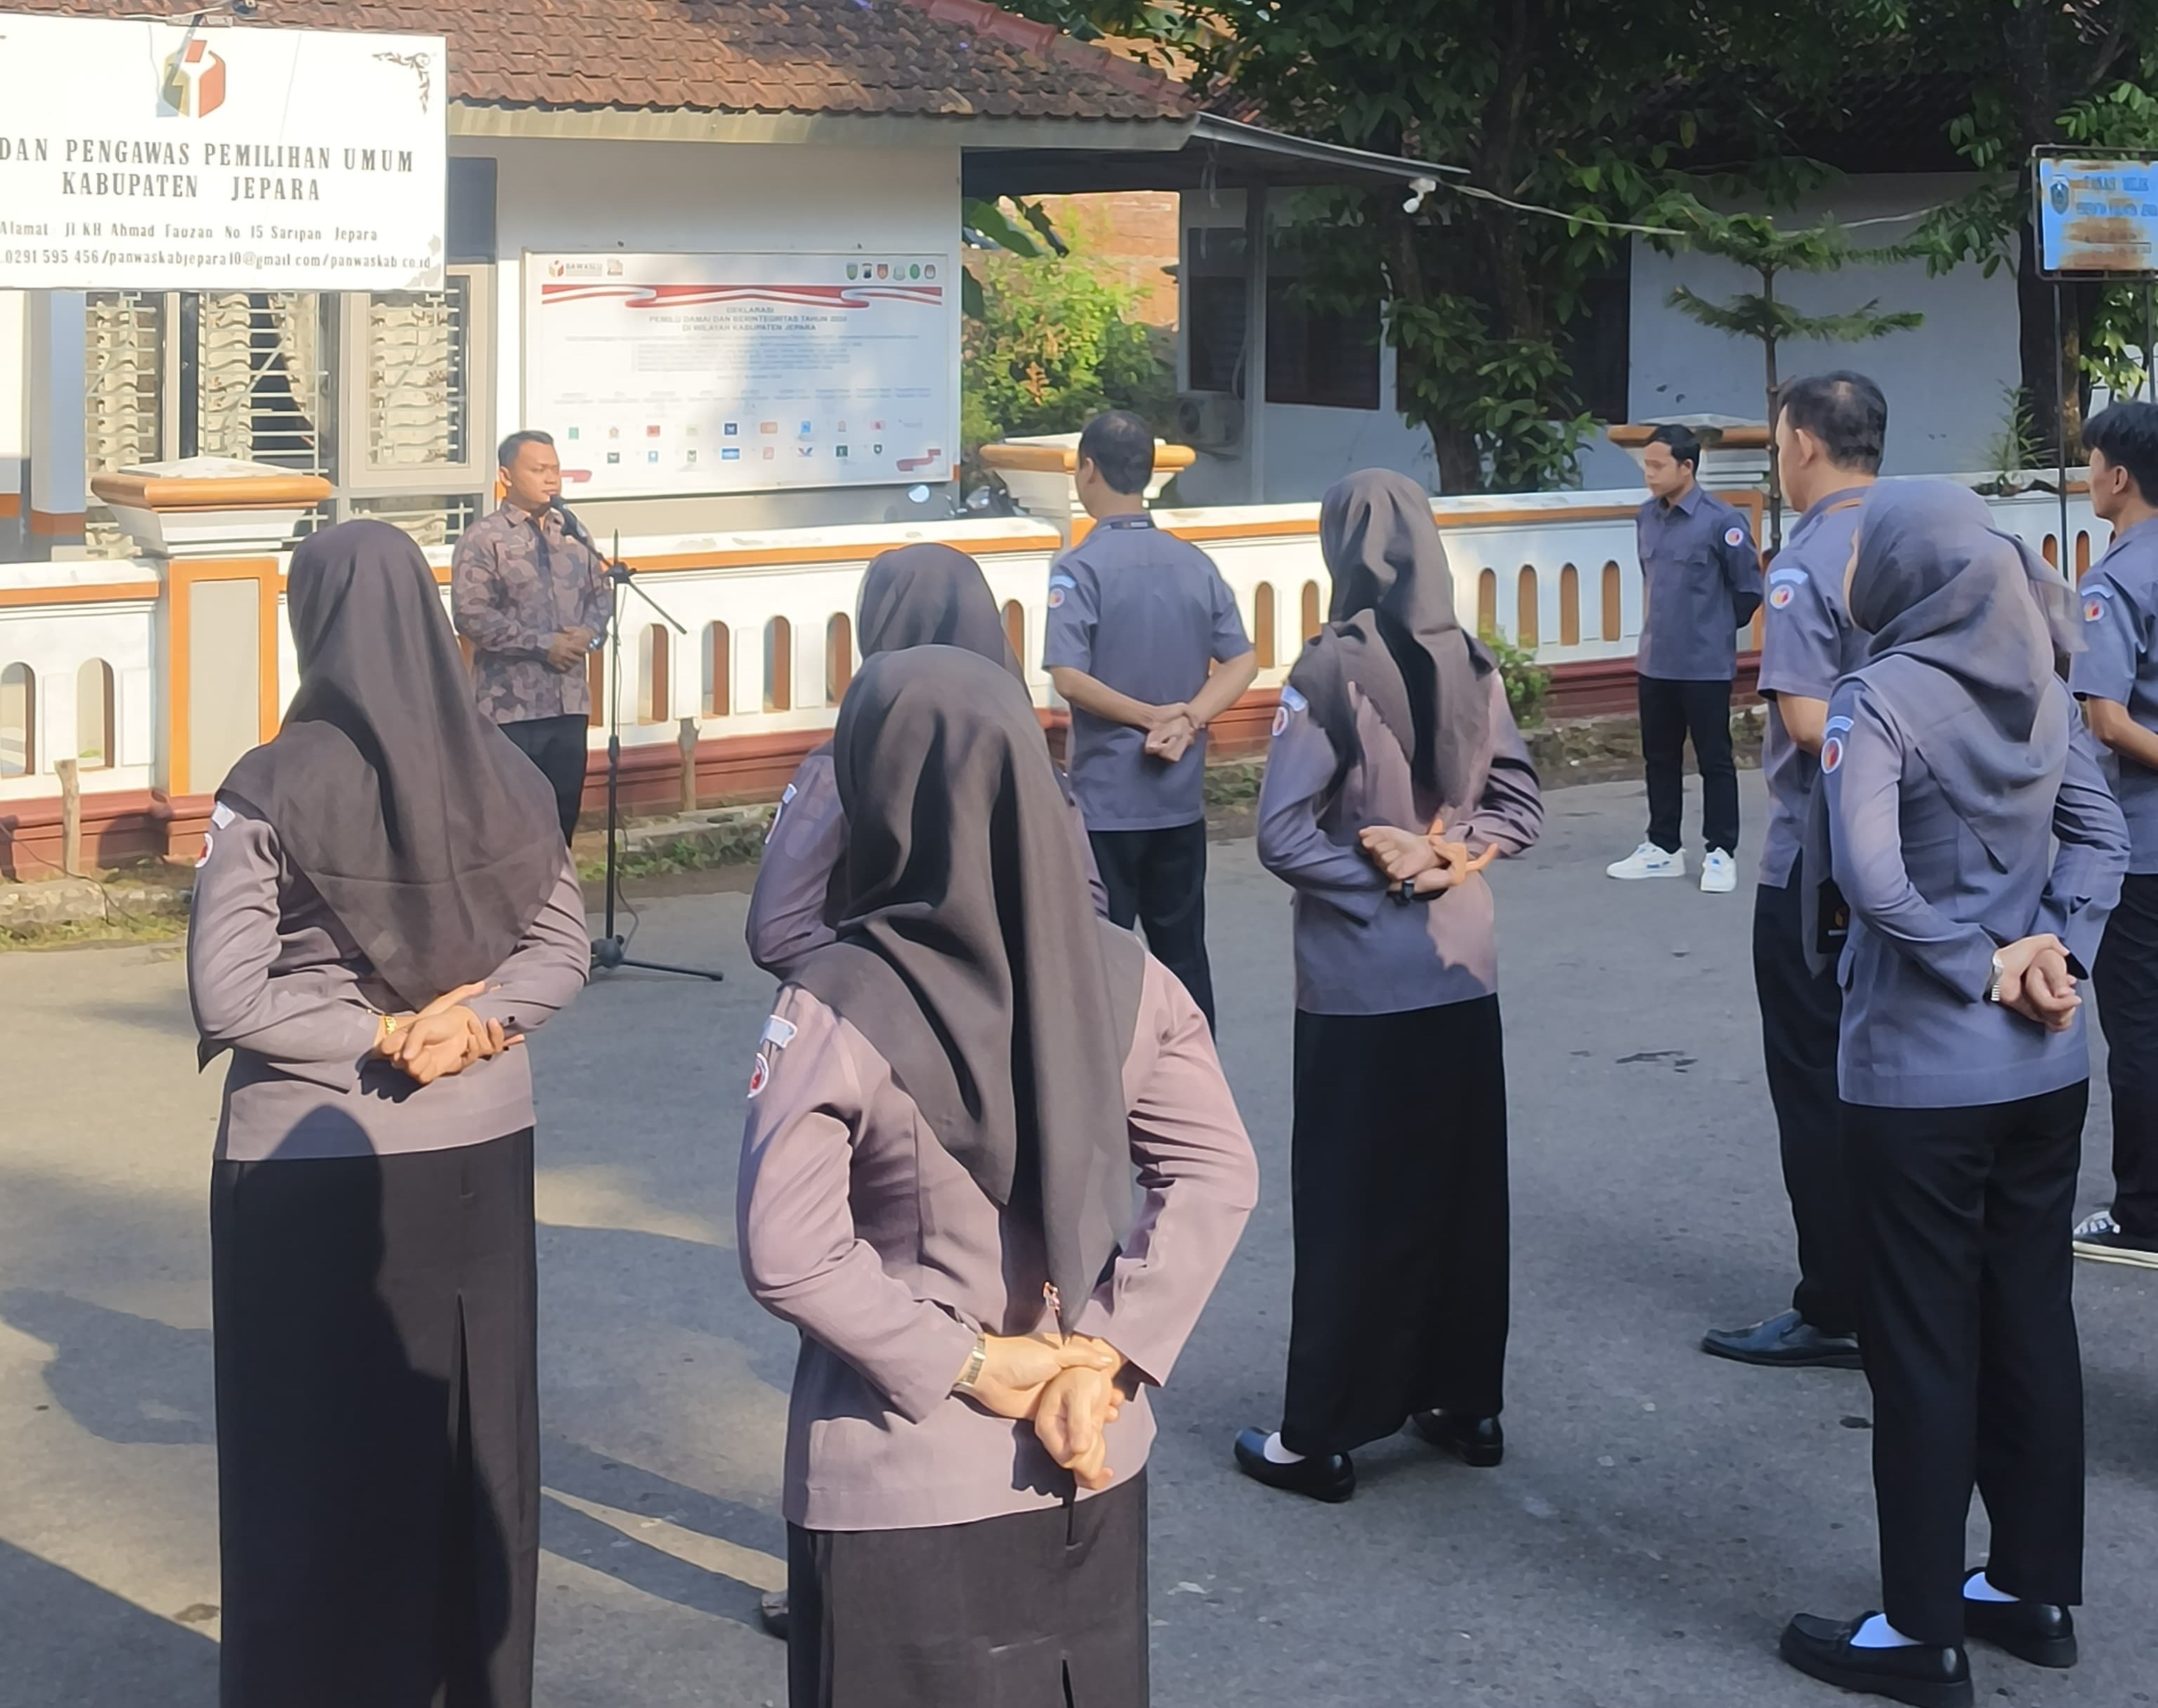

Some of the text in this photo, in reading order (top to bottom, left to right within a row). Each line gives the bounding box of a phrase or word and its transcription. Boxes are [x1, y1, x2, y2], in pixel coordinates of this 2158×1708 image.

[0, 137, 412, 172] DAN PENGAWAS PEMILIHAN UMUM
[63, 171, 320, 201] KABUPATEN JEPARA
[111, 222, 155, 237] Ahmad
[250, 224, 263, 239] 15
[270, 226, 322, 243] Saripan
[334, 226, 378, 243] Jepara
[5, 249, 37, 264] 0291
[43, 249, 68, 264] 595
